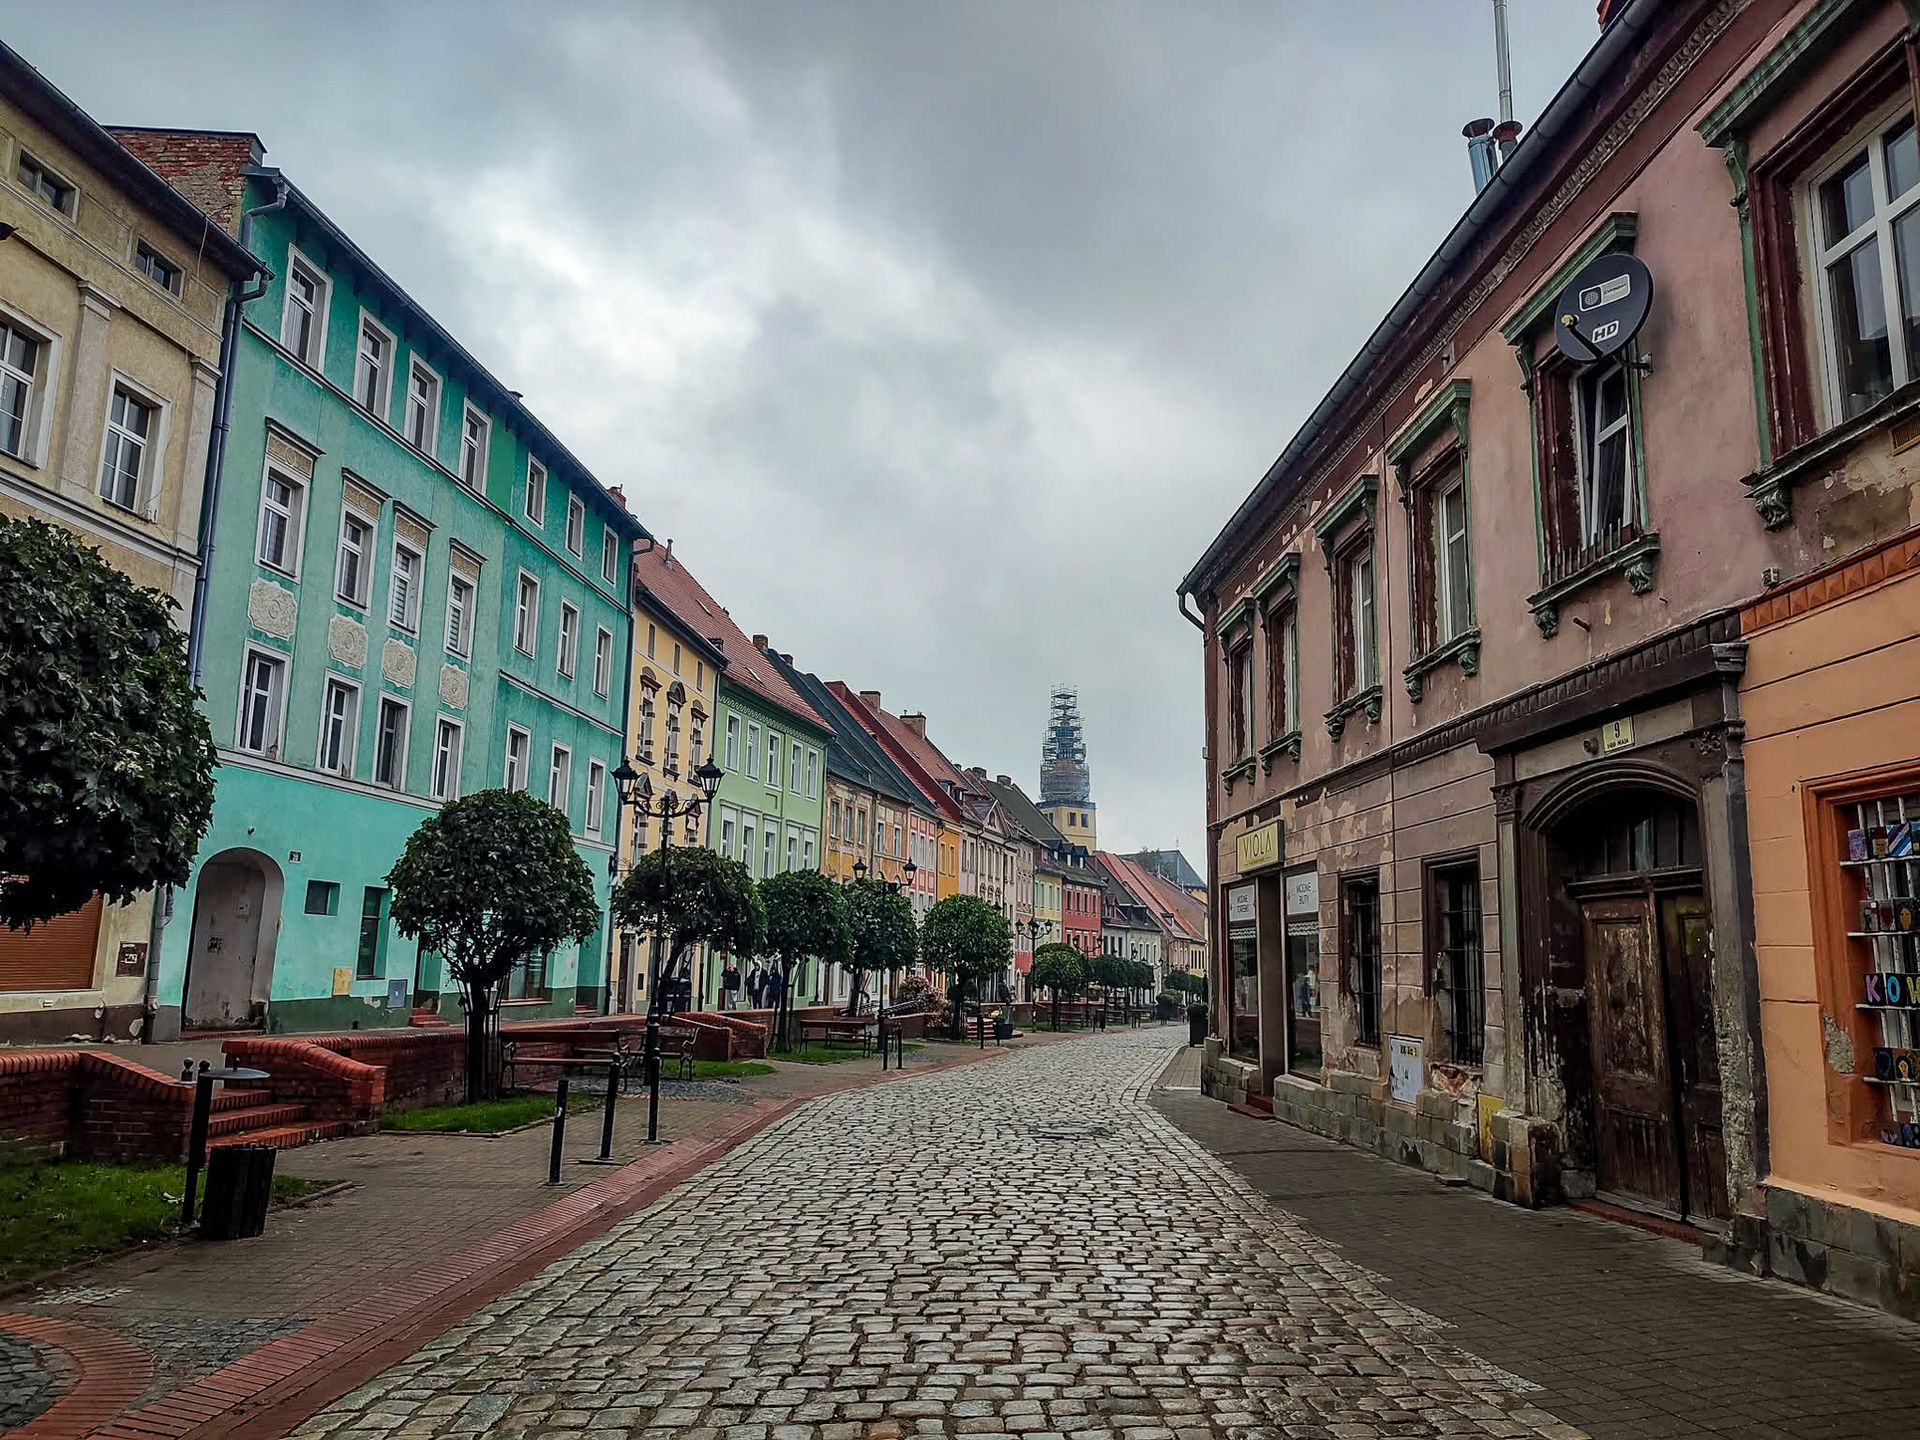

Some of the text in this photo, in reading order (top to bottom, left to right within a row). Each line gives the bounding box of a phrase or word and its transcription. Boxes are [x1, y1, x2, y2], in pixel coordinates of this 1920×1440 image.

[1594, 323, 1616, 341] HD
[1614, 722, 1620, 738] 9
[1243, 830, 1272, 859] VIOLA
[1297, 882, 1311, 893] MODNE
[1299, 895, 1309, 905] BUTY
